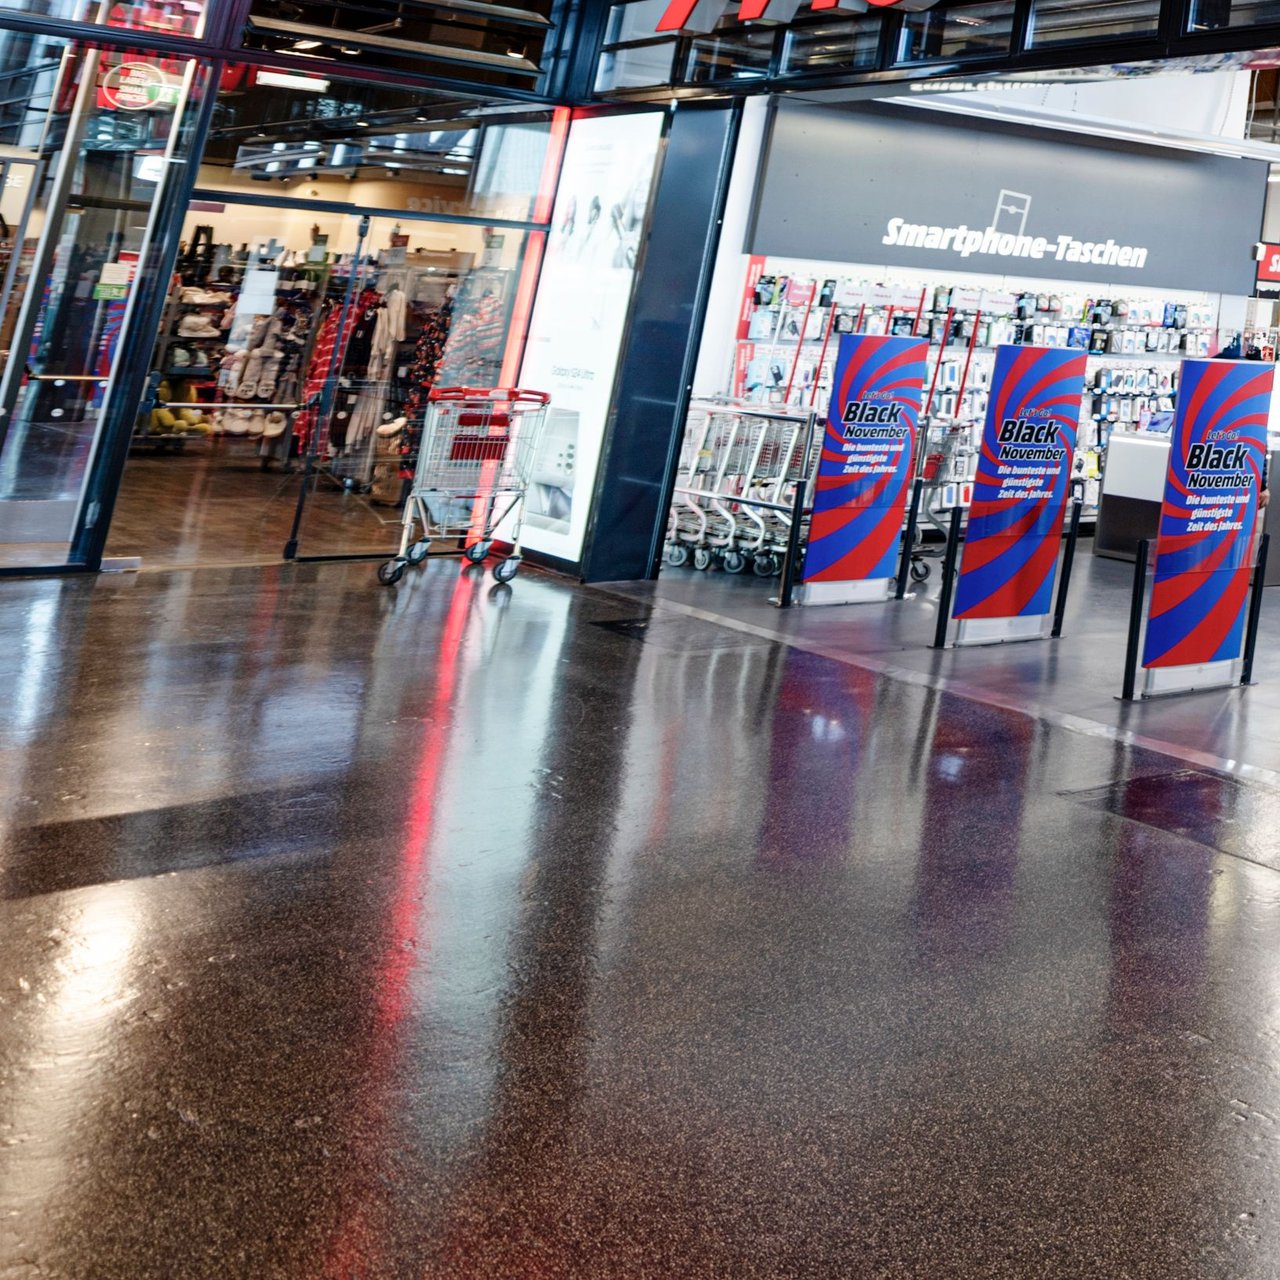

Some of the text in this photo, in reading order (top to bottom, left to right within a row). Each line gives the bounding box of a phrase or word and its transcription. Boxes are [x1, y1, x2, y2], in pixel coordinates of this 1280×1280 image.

[882, 217, 1148, 268] Smartphone-Taschen
[842, 402, 903, 424] Black
[843, 425, 910, 439] November
[997, 418, 1062, 445] Black
[842, 443, 856, 452] Die
[999, 445, 1066, 461] November
[1185, 441, 1251, 470] Black
[997, 465, 1011, 475] Die
[1186, 471, 1255, 489] November
[997, 488, 1013, 499] Zeit
[1014, 489, 1028, 499] des
[1186, 494, 1250, 505] Die bunteste und
[1186, 522, 1203, 532] Zeit
[1204, 521, 1218, 531] des
